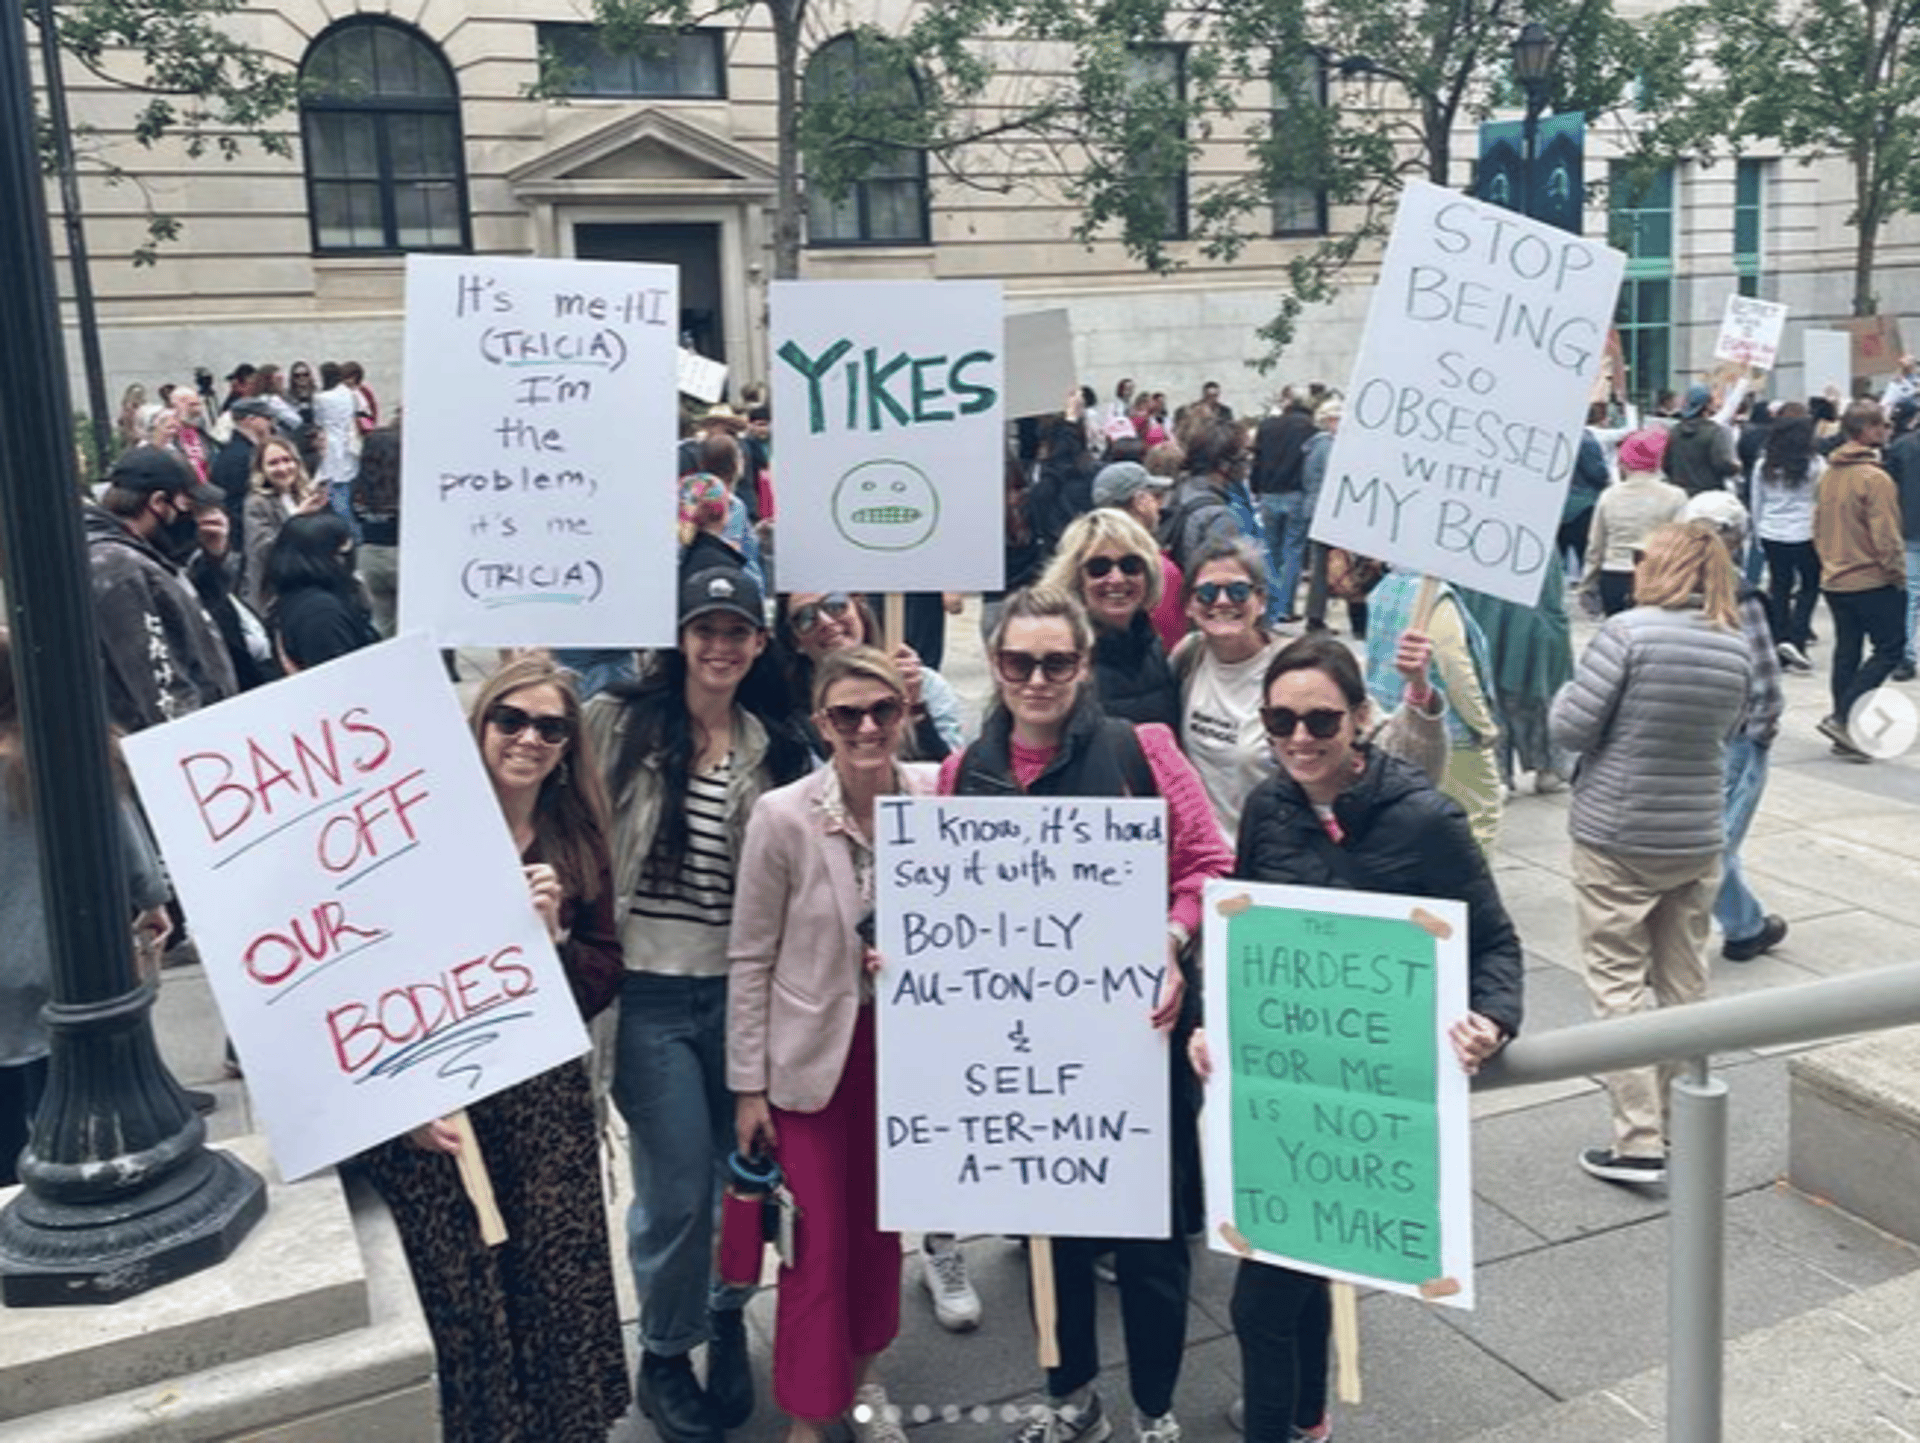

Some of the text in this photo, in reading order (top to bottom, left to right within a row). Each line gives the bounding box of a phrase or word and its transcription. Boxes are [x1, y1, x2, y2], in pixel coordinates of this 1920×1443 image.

[1433, 202, 1594, 292] STOP
[1405, 265, 1599, 376] BEING
[480, 327, 627, 372] (TRICIA)
[516, 375, 590, 404] I'm
[776, 338, 997, 435] YIKES
[1436, 351, 1496, 395] SO
[494, 416, 567, 451] the
[1354, 378, 1574, 483] OBSESSED
[438, 466, 598, 502] problem,
[1402, 452, 1503, 498] WITH
[470, 514, 592, 537] it's me
[1332, 474, 1545, 575] MY BOD
[461, 557, 604, 602] (TRICIA)
[180, 707, 391, 842] BANS
[317, 768, 429, 872] OFF
[881, 801, 915, 845] I
[1040, 806, 1091, 844] it's
[963, 850, 986, 886] it
[996, 849, 1056, 887] with
[242, 901, 384, 985] OUR
[902, 912, 1083, 956] BOD-I-LY
[891, 964, 1166, 1010] AU-TON-O-MY
[1242, 943, 1431, 998] HARDEST
[325, 945, 535, 1073] BODIES
[1257, 997, 1392, 1045] CHOICE
[965, 1062, 1084, 1096] SELF
[1241, 1043, 1398, 1097] FOR ME
[1247, 1097, 1411, 1143] IS NOT
[958, 1153, 1109, 1185] A-TION
[1277, 1136, 1415, 1193] YOURS
[1236, 1187, 1430, 1261] TO MAKE
